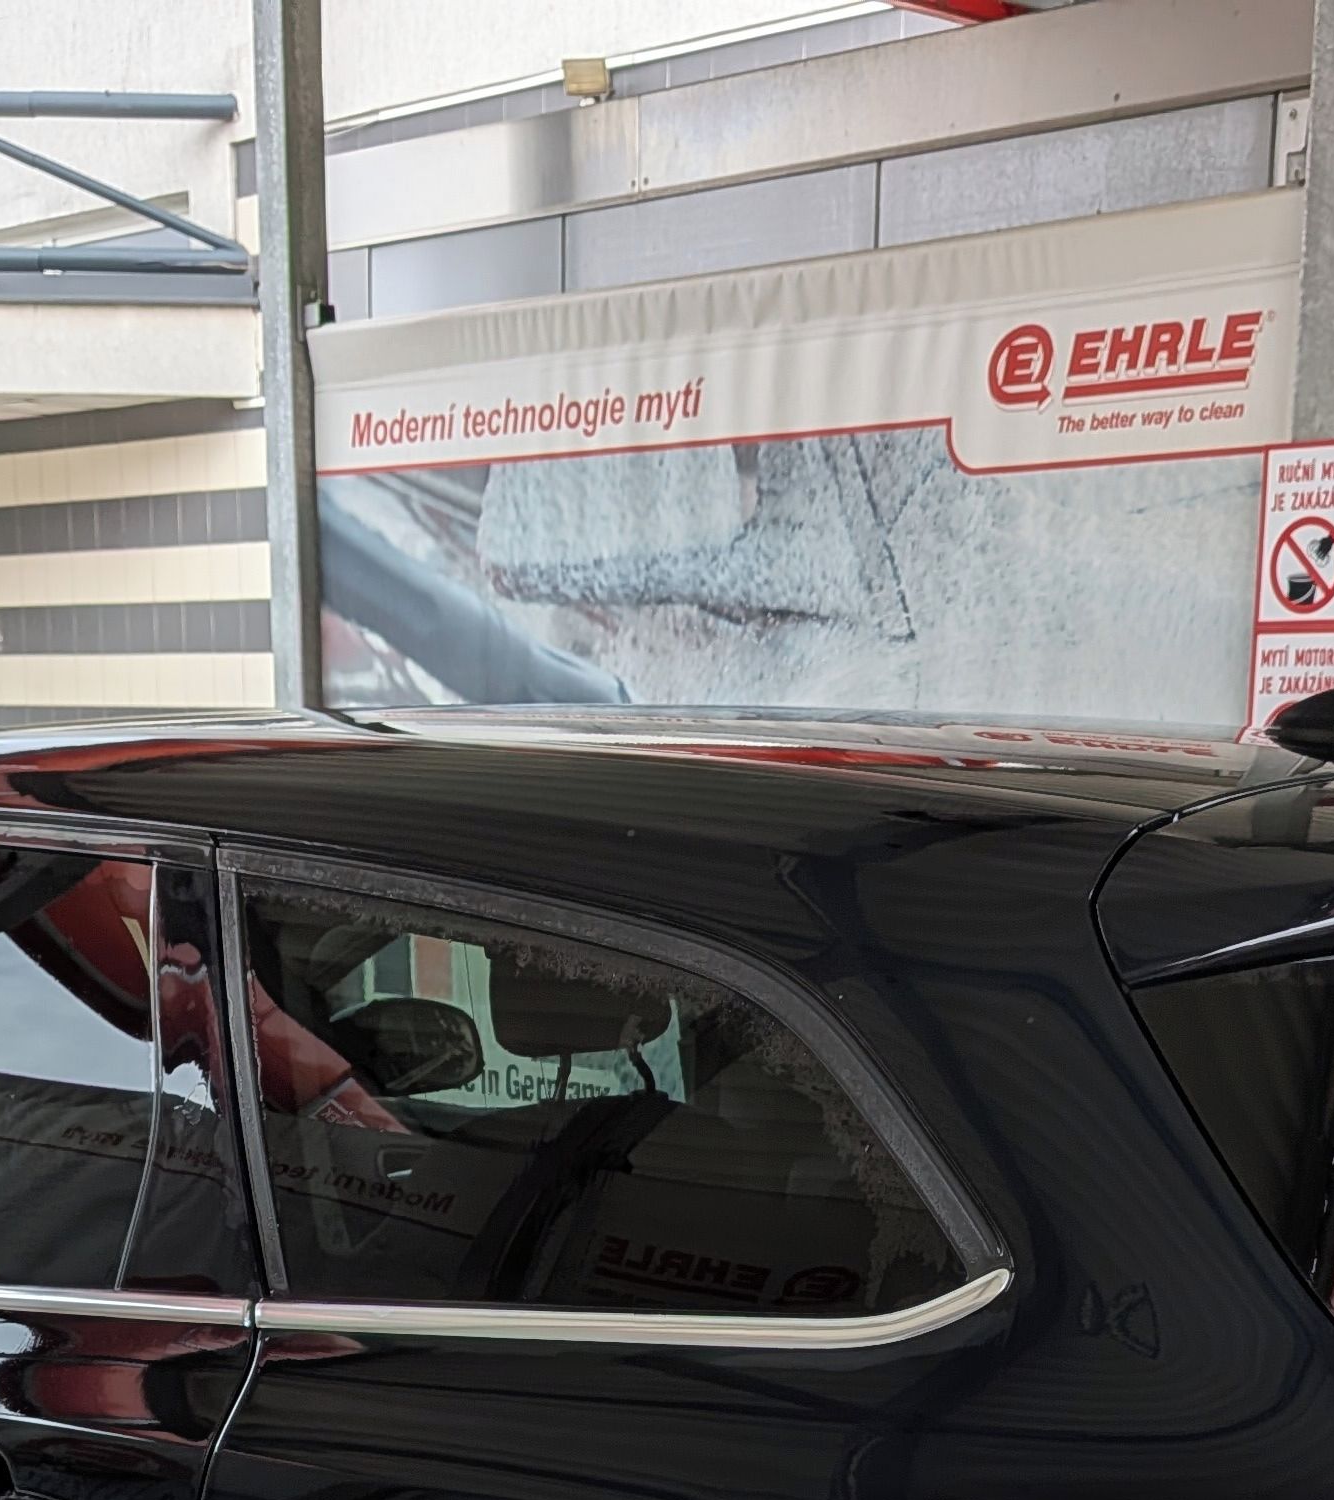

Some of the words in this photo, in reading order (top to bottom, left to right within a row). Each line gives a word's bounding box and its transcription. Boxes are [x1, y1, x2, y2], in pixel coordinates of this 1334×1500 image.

[1067, 311, 1263, 379] EHRLE
[351, 404, 455, 449] Moderní
[463, 388, 625, 438] technologie
[634, 376, 705, 431] mytí
[1058, 416, 1085, 433] The
[1089, 412, 1136, 431] better
[1141, 410, 1173, 429] way
[1178, 405, 1195, 423] to
[1199, 402, 1244, 421] clean
[1278, 458, 1316, 484] RUČNÍ
[1271, 491, 1286, 512] JE
[1261, 644, 1289, 667] MYTÍ
[1259, 677, 1273, 694] JE
